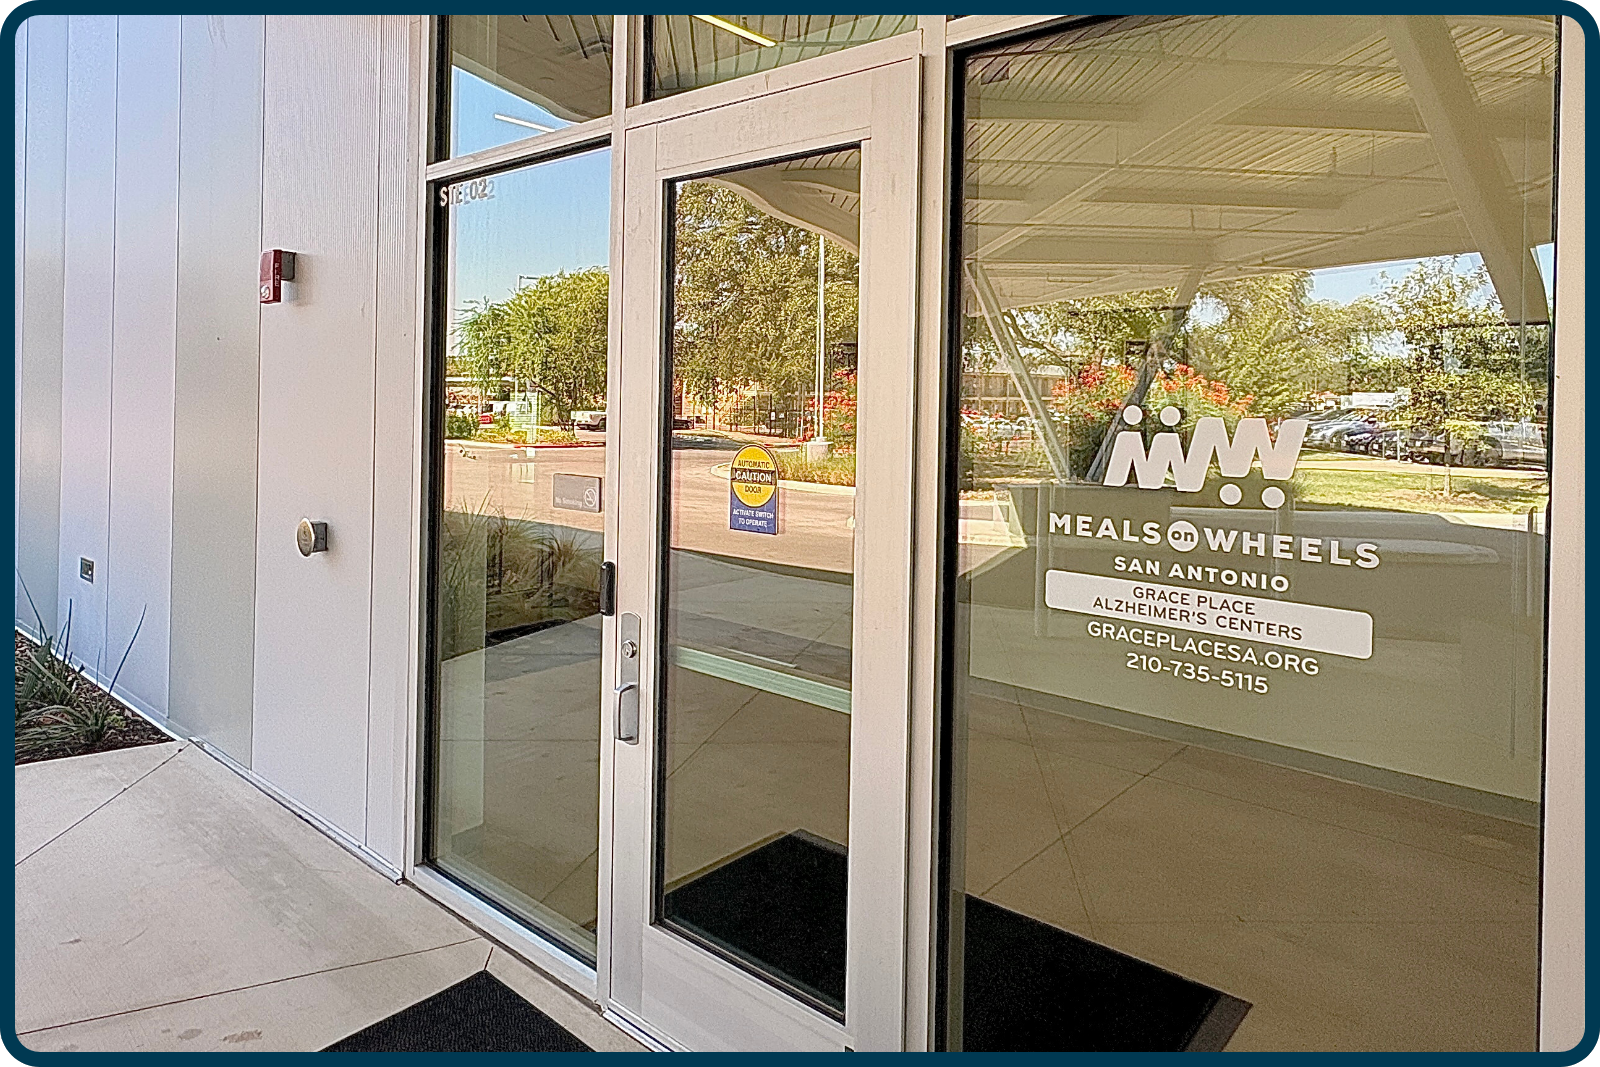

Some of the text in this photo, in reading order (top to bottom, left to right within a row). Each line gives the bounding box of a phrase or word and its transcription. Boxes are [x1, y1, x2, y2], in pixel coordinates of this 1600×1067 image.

[735, 471, 772, 483] CAUTION
[737, 459, 770, 469] AUTOMATIC
[744, 485, 761, 494] DOOR
[732, 508, 755, 517] ACTIVATE
[1049, 512, 1380, 569] MEALS on WHEELS
[1113, 556, 1289, 592] SAN ANTONIO
[1133, 586, 1256, 616] GRACE PLACE
[1093, 597, 1303, 641] ALZHEIMER'S CENTERS
[1087, 620, 1320, 676] GRACEPLACESA.ORG
[1126, 652, 1269, 695] 210-735-5115
